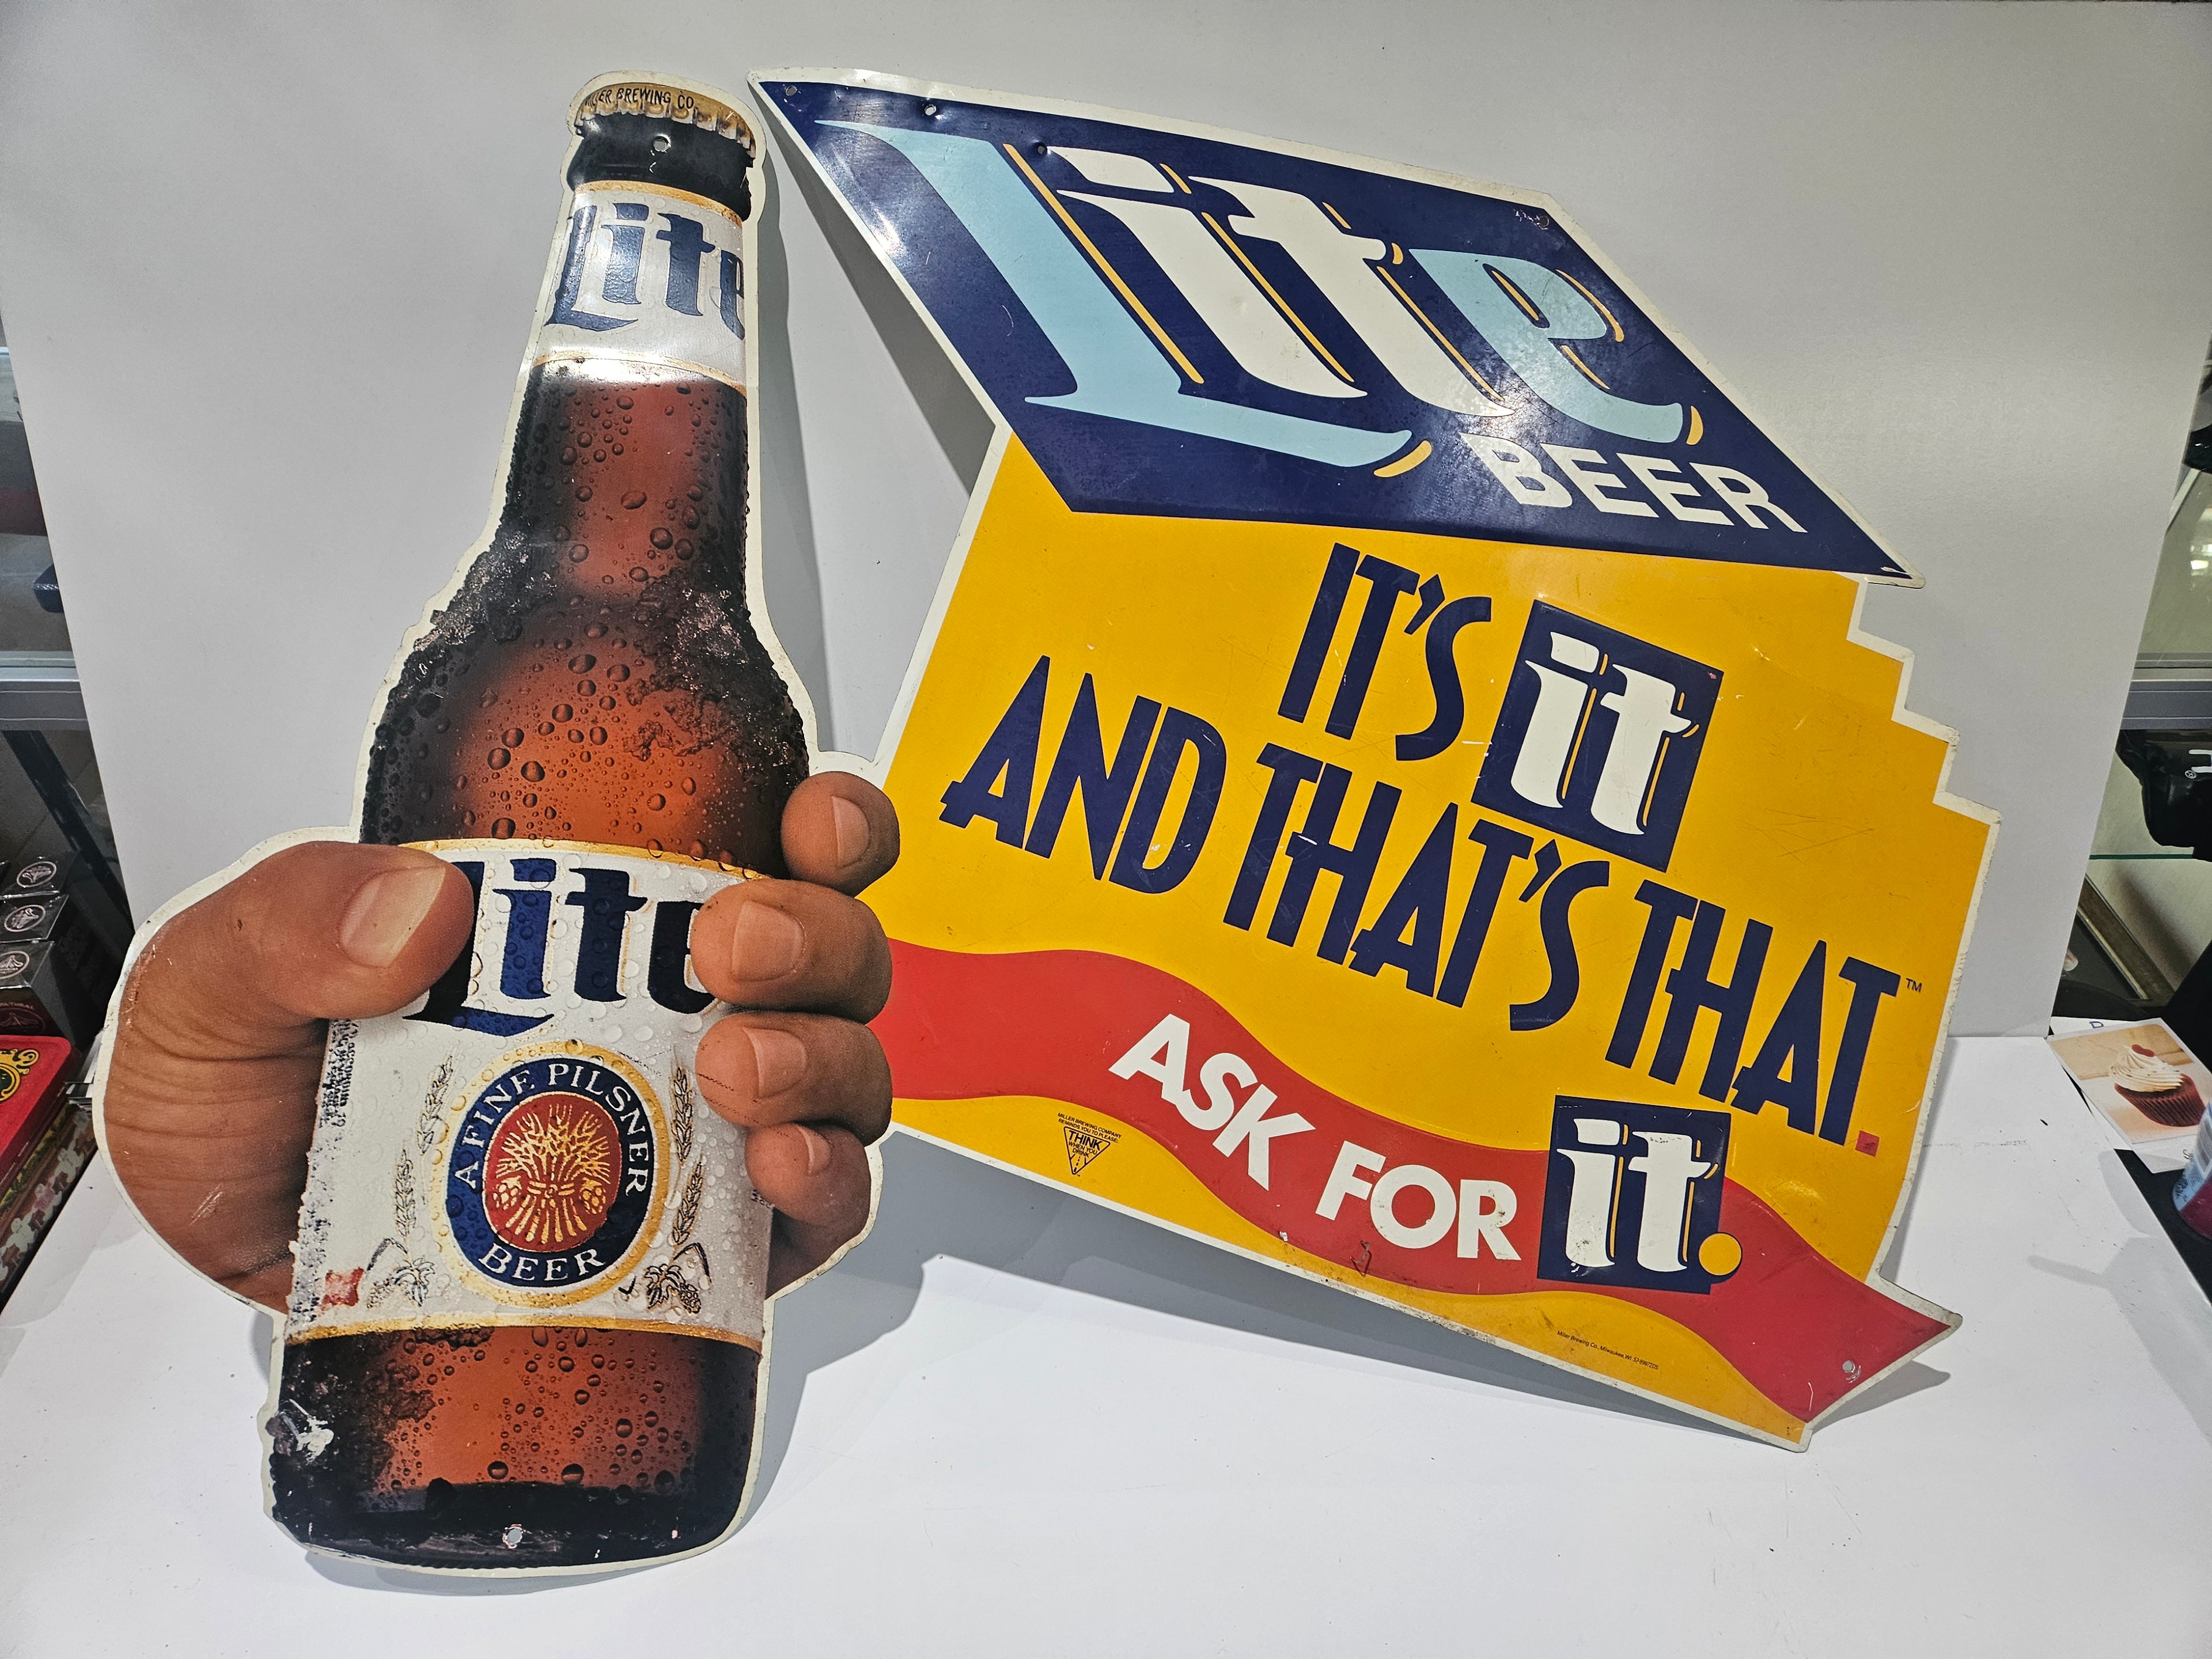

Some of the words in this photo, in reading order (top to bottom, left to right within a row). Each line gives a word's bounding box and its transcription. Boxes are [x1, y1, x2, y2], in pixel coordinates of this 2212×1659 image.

[616, 86, 671, 105] BREWING
[813, 119, 1684, 468] Lite
[1457, 431, 1808, 533] BEER
[1280, 544, 1491, 760] IT'S
[1510, 631, 1692, 836] it
[941, 657, 1226, 893] AND
[1224, 744, 1609, 1031] THAT'S
[1607, 881, 1898, 1156] THAT.
[462, 1069, 535, 1149] FINE
[1058, 1112, 1076, 1122] MILLER
[1075, 1119, 1098, 1130] BREWING
[1098, 1127, 1122, 1139] COMPANY
[548, 1063, 649, 1197] PILSNER
[1058, 1118, 1080, 1130] REMINDS
[1081, 1126, 1092, 1135] YOU
[1069, 1130, 1103, 1151] THINK
[1108, 1013, 1316, 1191] ASK
[1315, 1141, 1522, 1261] FOR
[1069, 1141, 1086, 1151] WHEN
[1086, 1146, 1098, 1156] YOU
[1072, 1147, 1090, 1158] DRINK
[454, 1161, 479, 1190] A
[478, 1243, 606, 1282] BEER
[1557, 1330, 1570, 1338] Miller
[1570, 1335, 1590, 1347] Brewing
